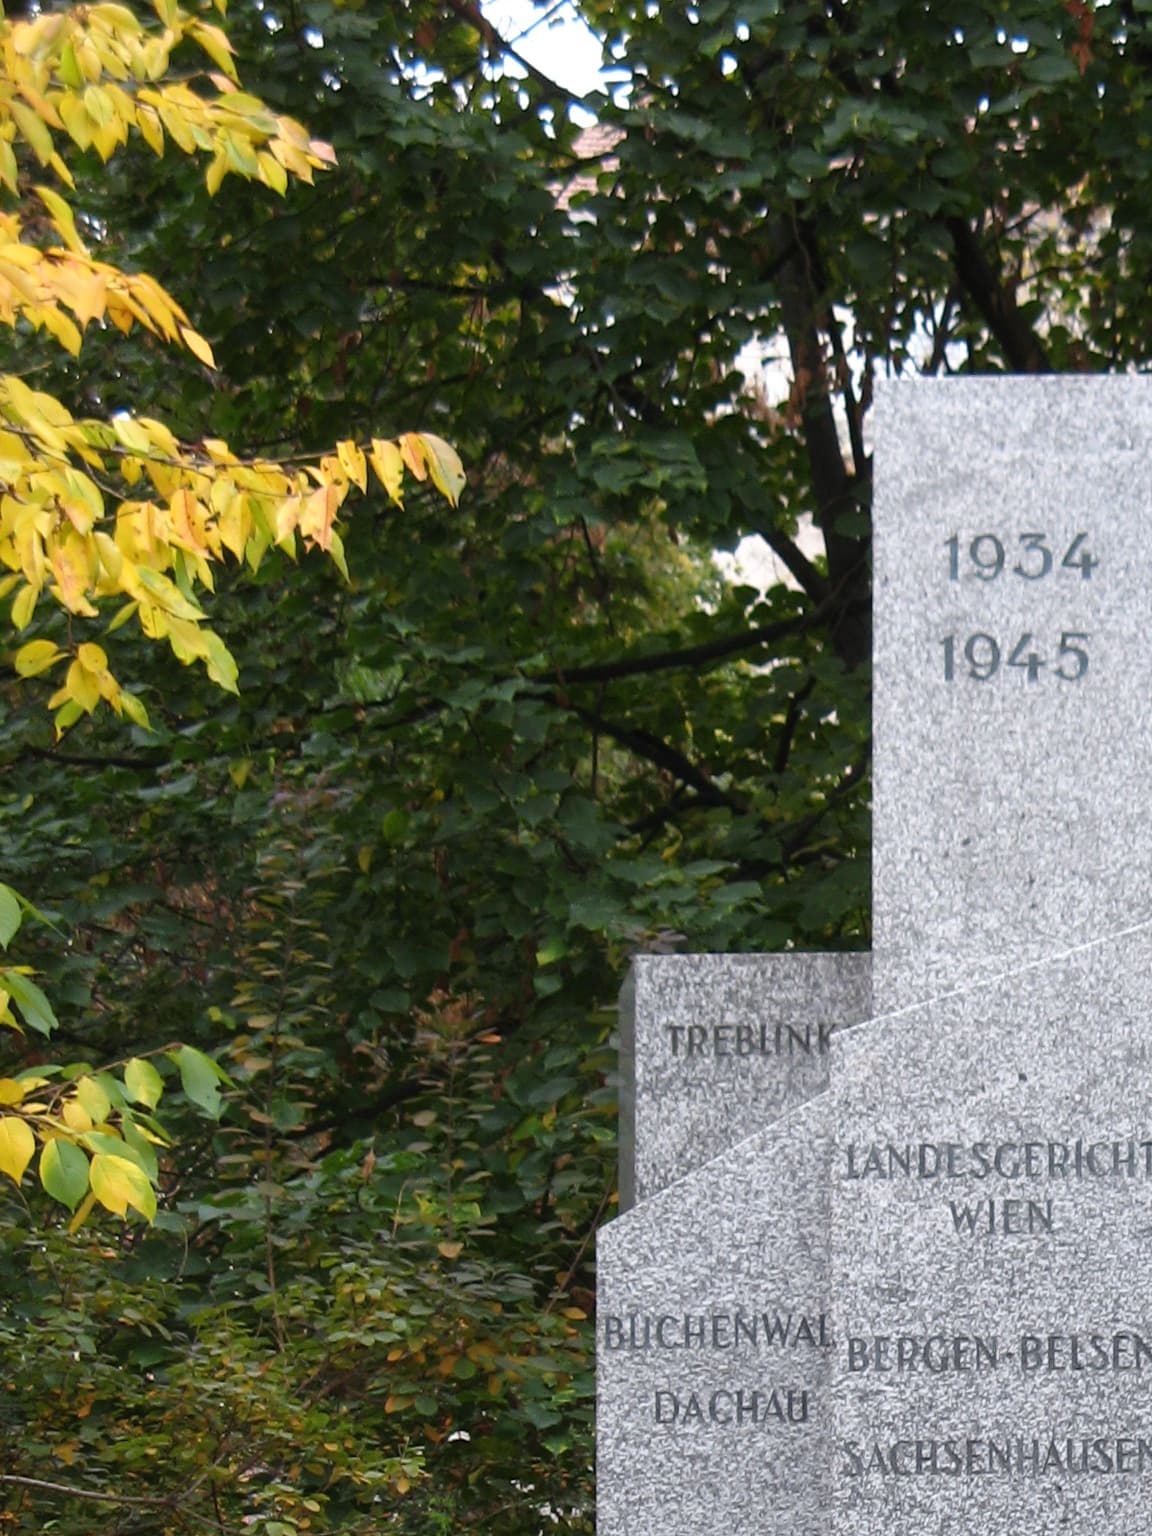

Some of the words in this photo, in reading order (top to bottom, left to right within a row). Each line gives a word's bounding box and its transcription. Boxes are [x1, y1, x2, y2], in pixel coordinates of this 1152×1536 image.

[943, 533, 1099, 581] 1934
[940, 632, 1091, 681] 1945
[666, 1023, 837, 1057] TREBLINK
[950, 1199, 1055, 1236] WIEN
[604, 1313, 837, 1350] BUCHENWAL
[655, 1390, 809, 1424] DACHAU
